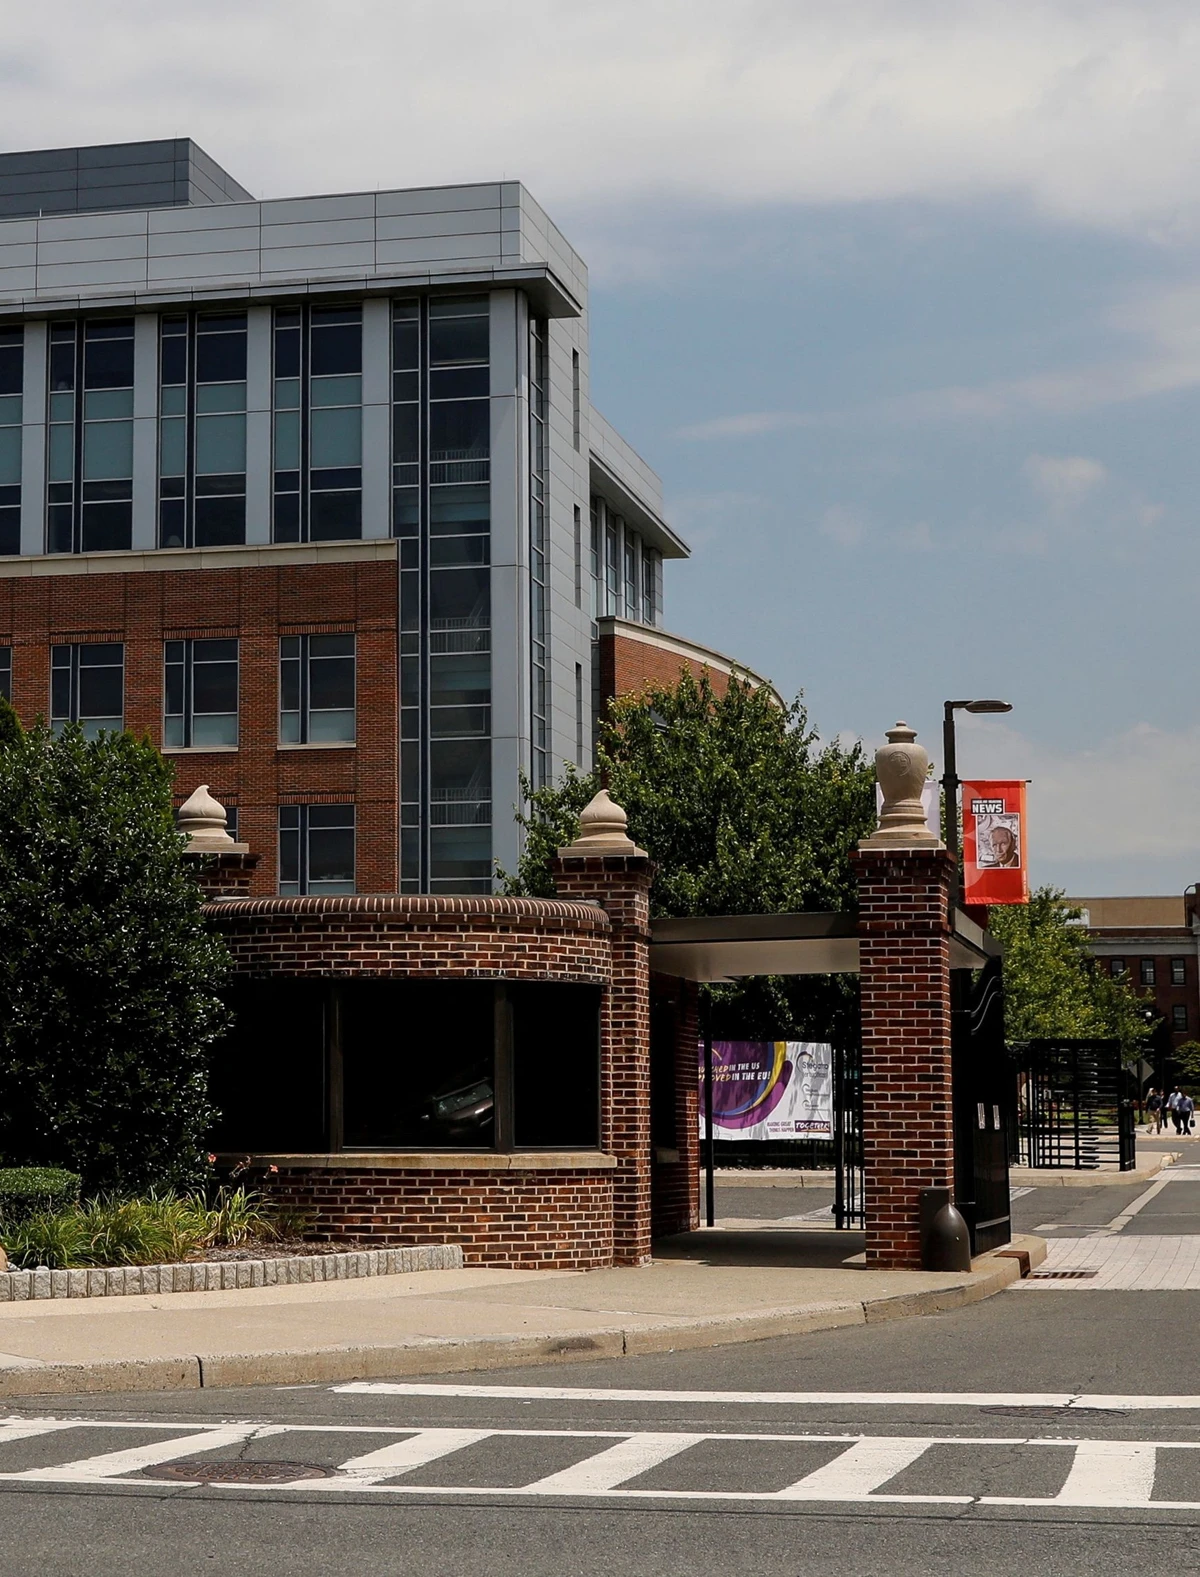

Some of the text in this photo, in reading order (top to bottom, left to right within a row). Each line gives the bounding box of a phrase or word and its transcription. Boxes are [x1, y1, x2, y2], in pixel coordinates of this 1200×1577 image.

[972, 804, 1002, 813] NEWS
[729, 1063, 736, 1071] IN
[737, 1062, 749, 1071] THE
[751, 1062, 760, 1070] US
[732, 1072, 740, 1080] IN
[742, 1072, 755, 1080] THE
[757, 1071, 771, 1080] EU!
